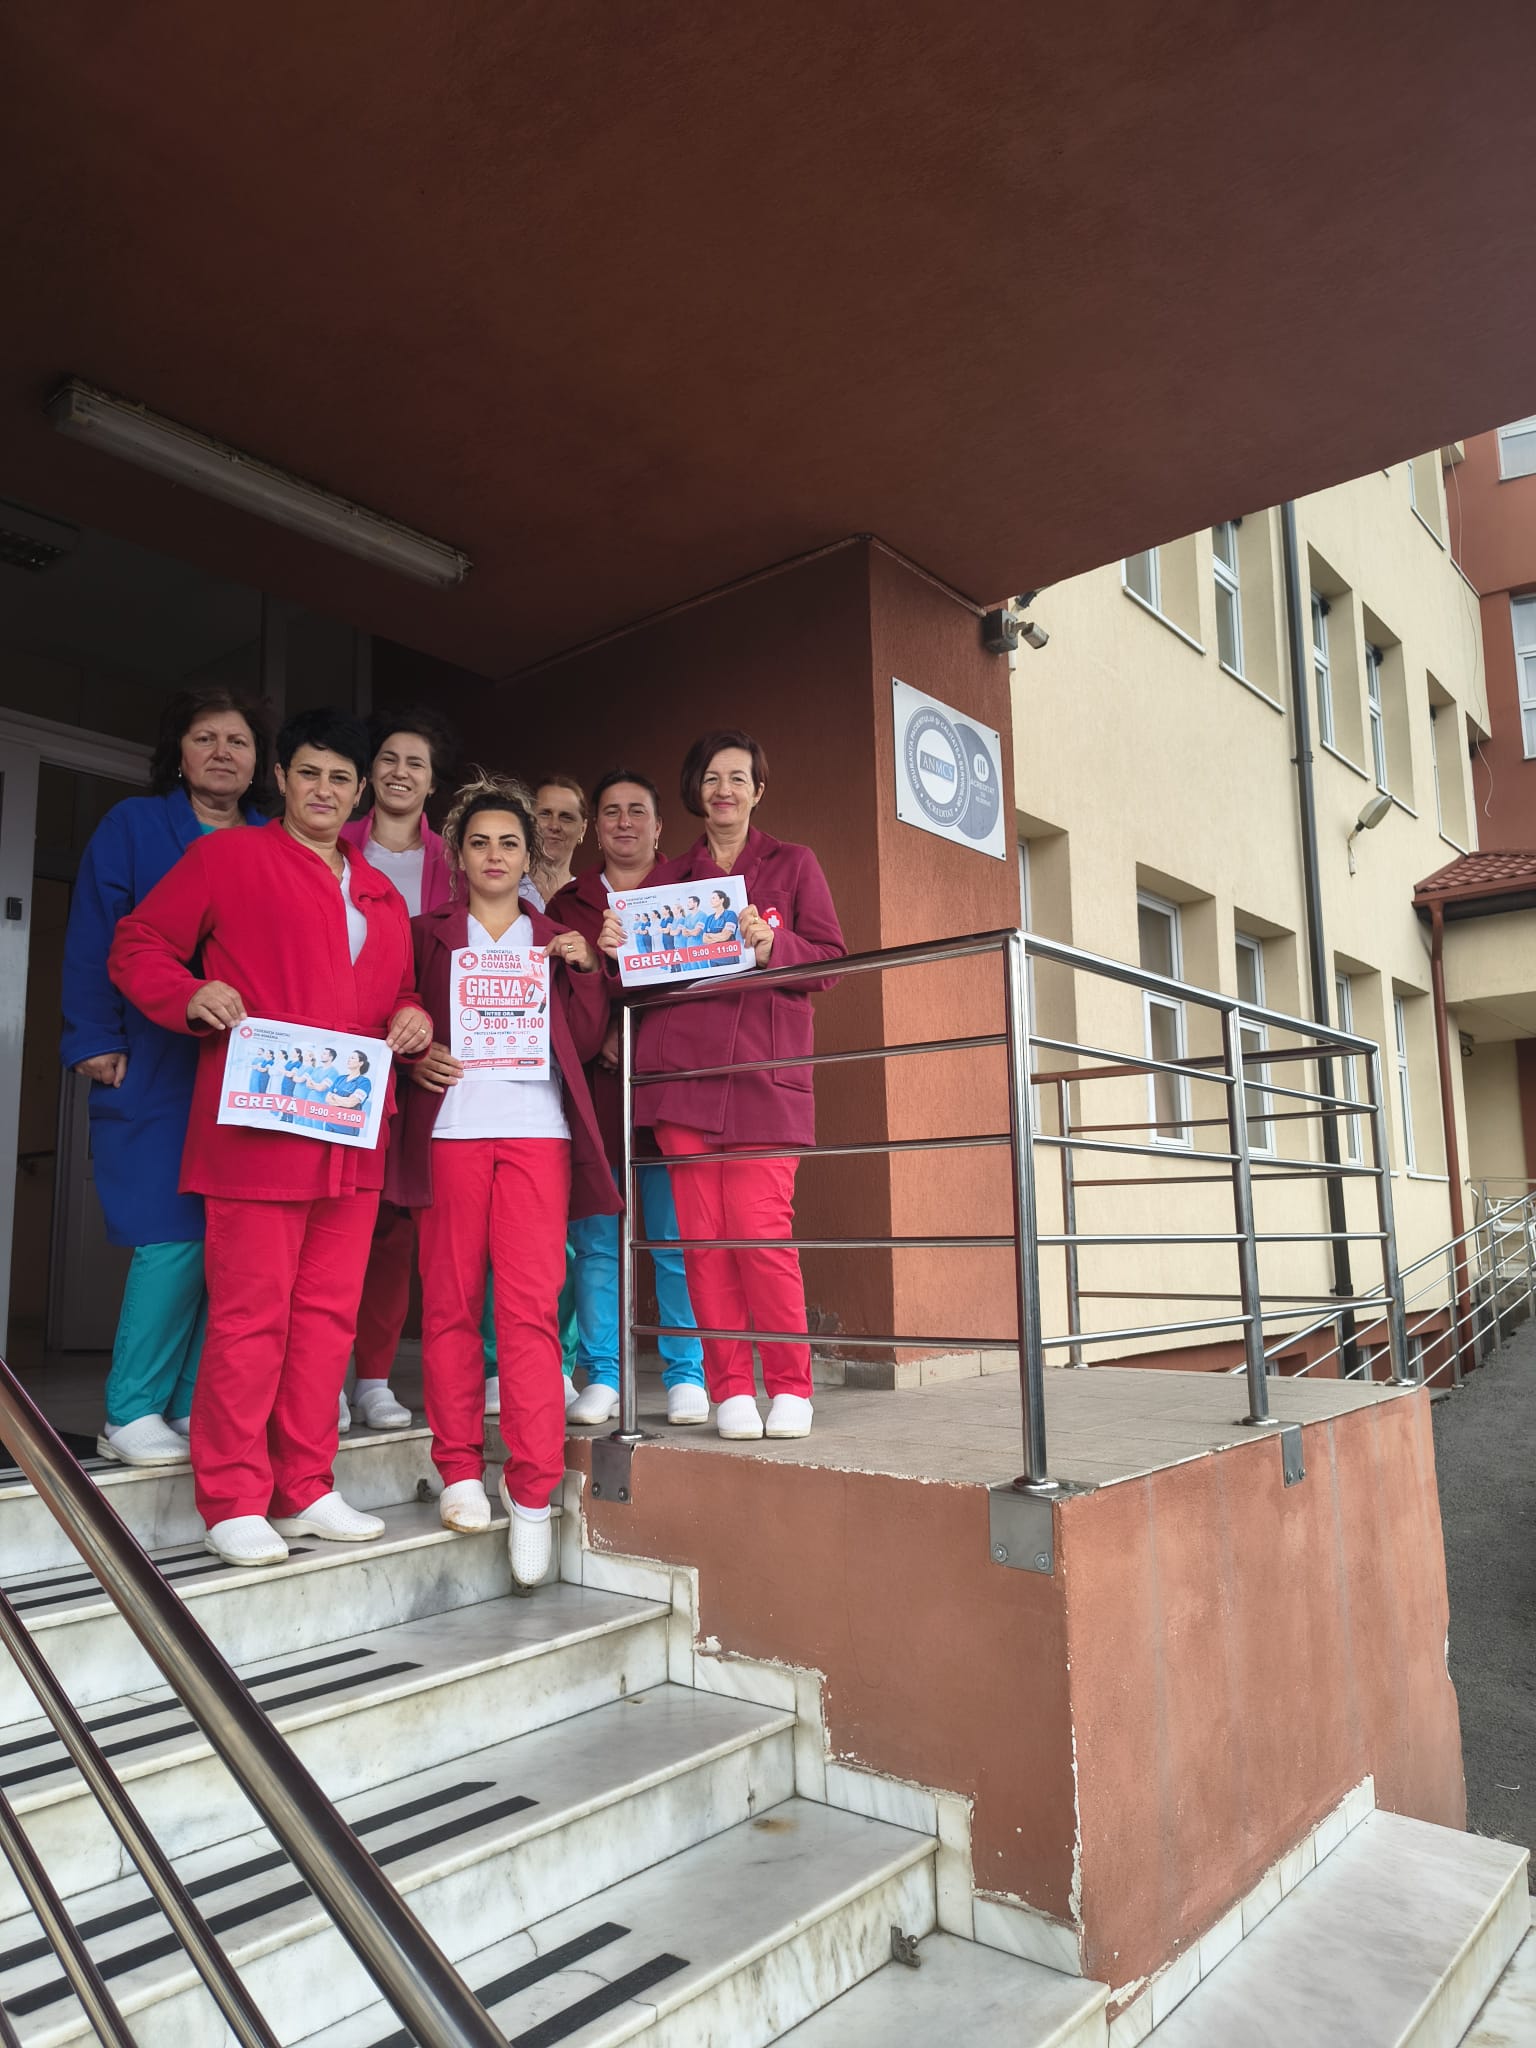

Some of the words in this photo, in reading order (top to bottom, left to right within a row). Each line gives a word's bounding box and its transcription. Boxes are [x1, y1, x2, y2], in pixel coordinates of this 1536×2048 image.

[921, 752, 954, 781] ANMCS
[481, 953, 521, 962] SANITAS
[629, 948, 684, 969] GREVĂ
[692, 947, 710, 958] 9:00
[716, 944, 738, 955] 11:00
[481, 961, 522, 969] COVASNA
[466, 997, 476, 1005] DE
[477, 997, 524, 1006] AVERTISMENT
[483, 1018, 508, 1030] 9:00
[516, 1017, 544, 1029] 11:00
[234, 1095, 297, 1113] GREVĂ
[309, 1106, 330, 1118] 9:00
[336, 1112, 362, 1123] 11:00
